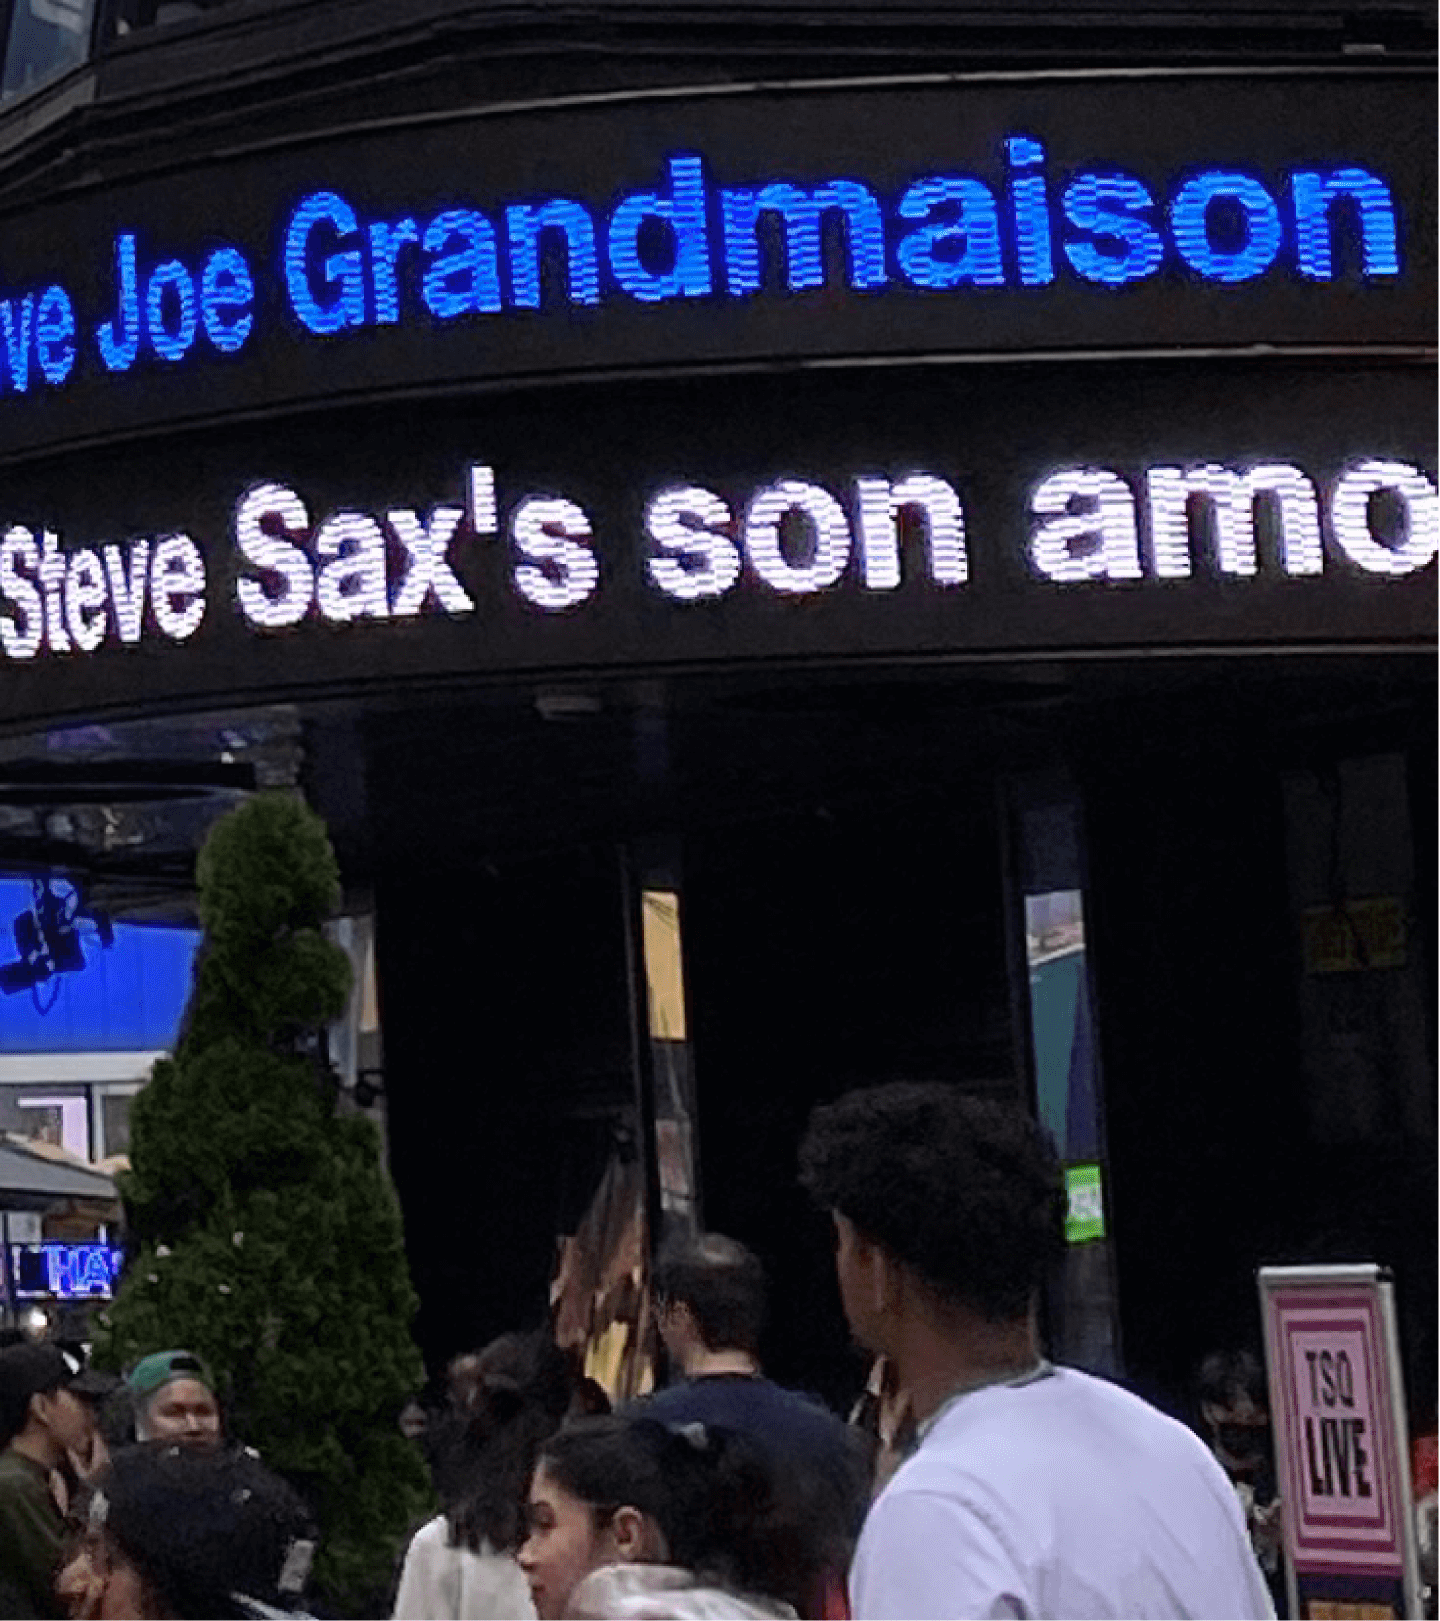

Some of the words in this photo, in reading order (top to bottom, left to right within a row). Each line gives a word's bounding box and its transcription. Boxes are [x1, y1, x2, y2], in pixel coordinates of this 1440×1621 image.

[96, 234, 255, 371] Joe
[284, 135, 1401, 336] Grandmaison
[236, 467, 600, 632] Sax's
[641, 470, 970, 604] son
[1304, 1349, 1355, 1408] TSQ
[1304, 1416, 1373, 1498] LIVE
